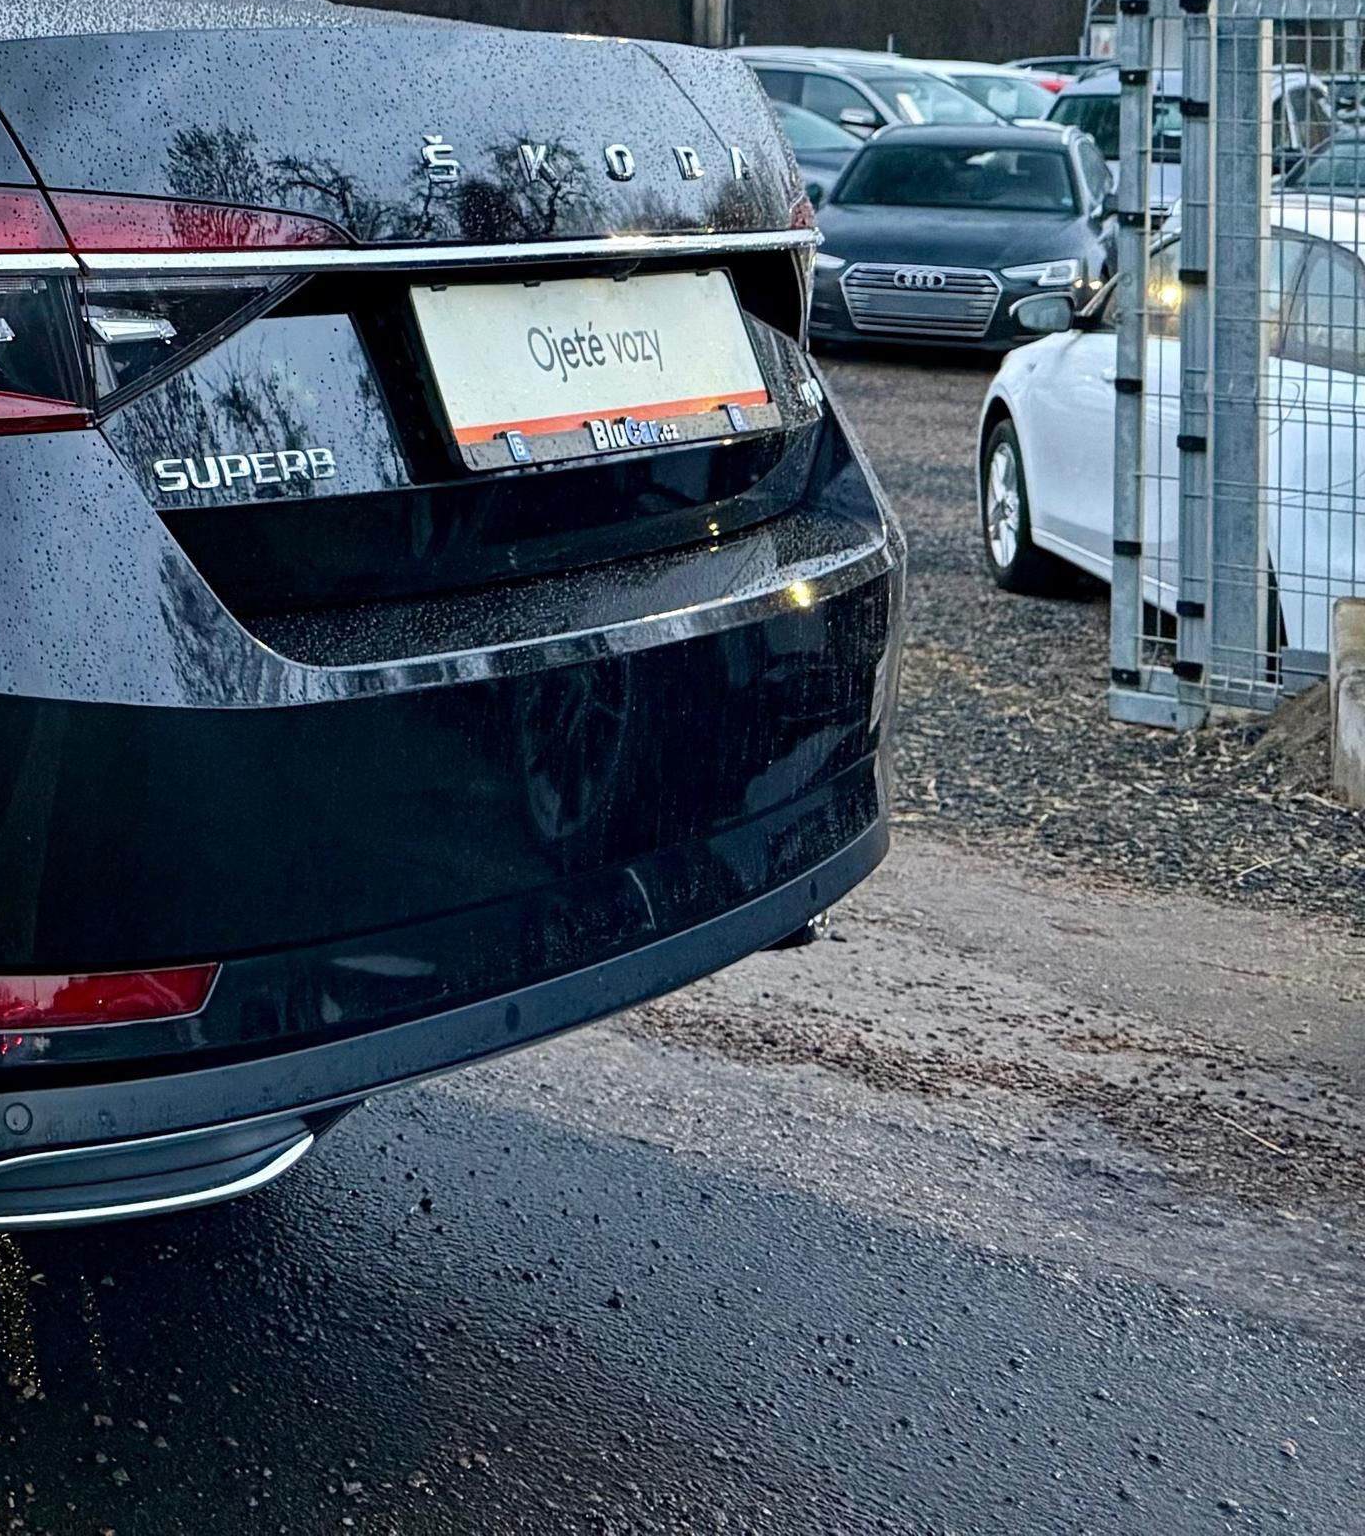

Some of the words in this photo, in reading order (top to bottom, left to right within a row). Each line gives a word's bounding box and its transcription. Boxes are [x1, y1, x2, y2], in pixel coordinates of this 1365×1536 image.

[421, 134, 756, 185] ŠKODA
[527, 321, 606, 383] Ojeté
[606, 329, 664, 372] vozy
[589, 416, 680, 451] BluCar.cz
[153, 447, 338, 492] SUPERB
